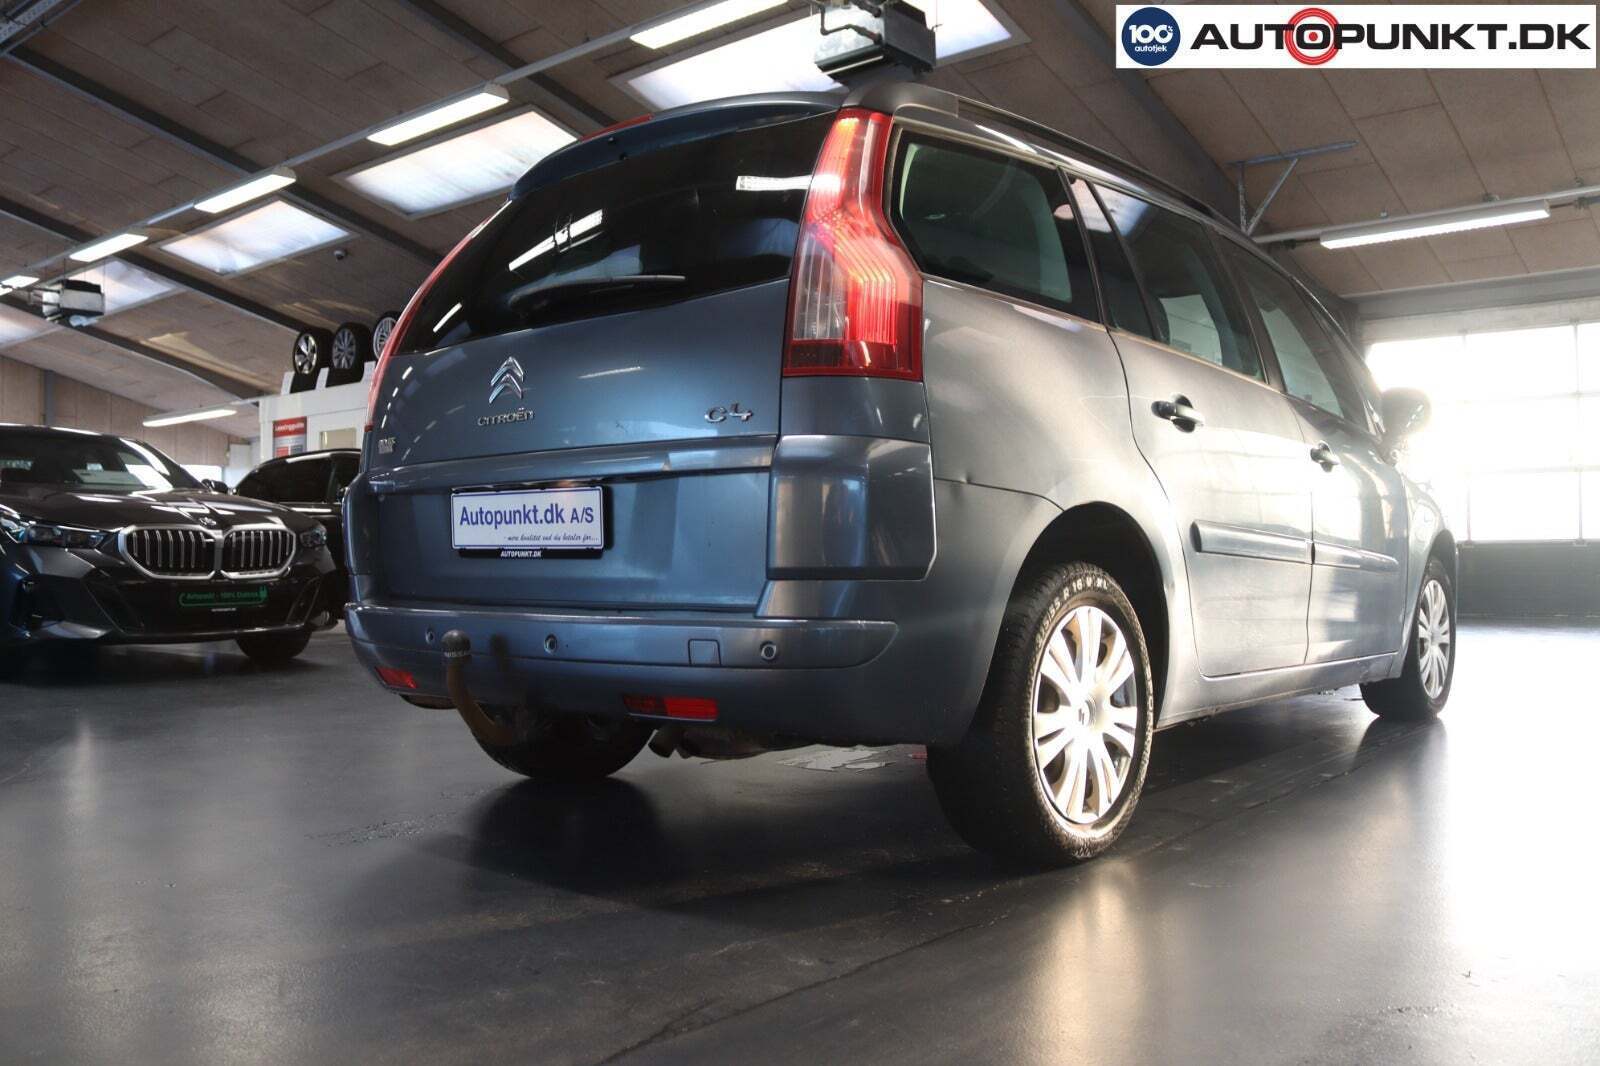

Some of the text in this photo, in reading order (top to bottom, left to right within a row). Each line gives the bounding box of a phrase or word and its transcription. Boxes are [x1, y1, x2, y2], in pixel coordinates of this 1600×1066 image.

[477, 407, 535, 427] CITROËN
[703, 400, 754, 423] C4
[459, 503, 594, 530] Autopunkt.dk A/S
[500, 550, 542, 559] AUTOPUNKT.DK
